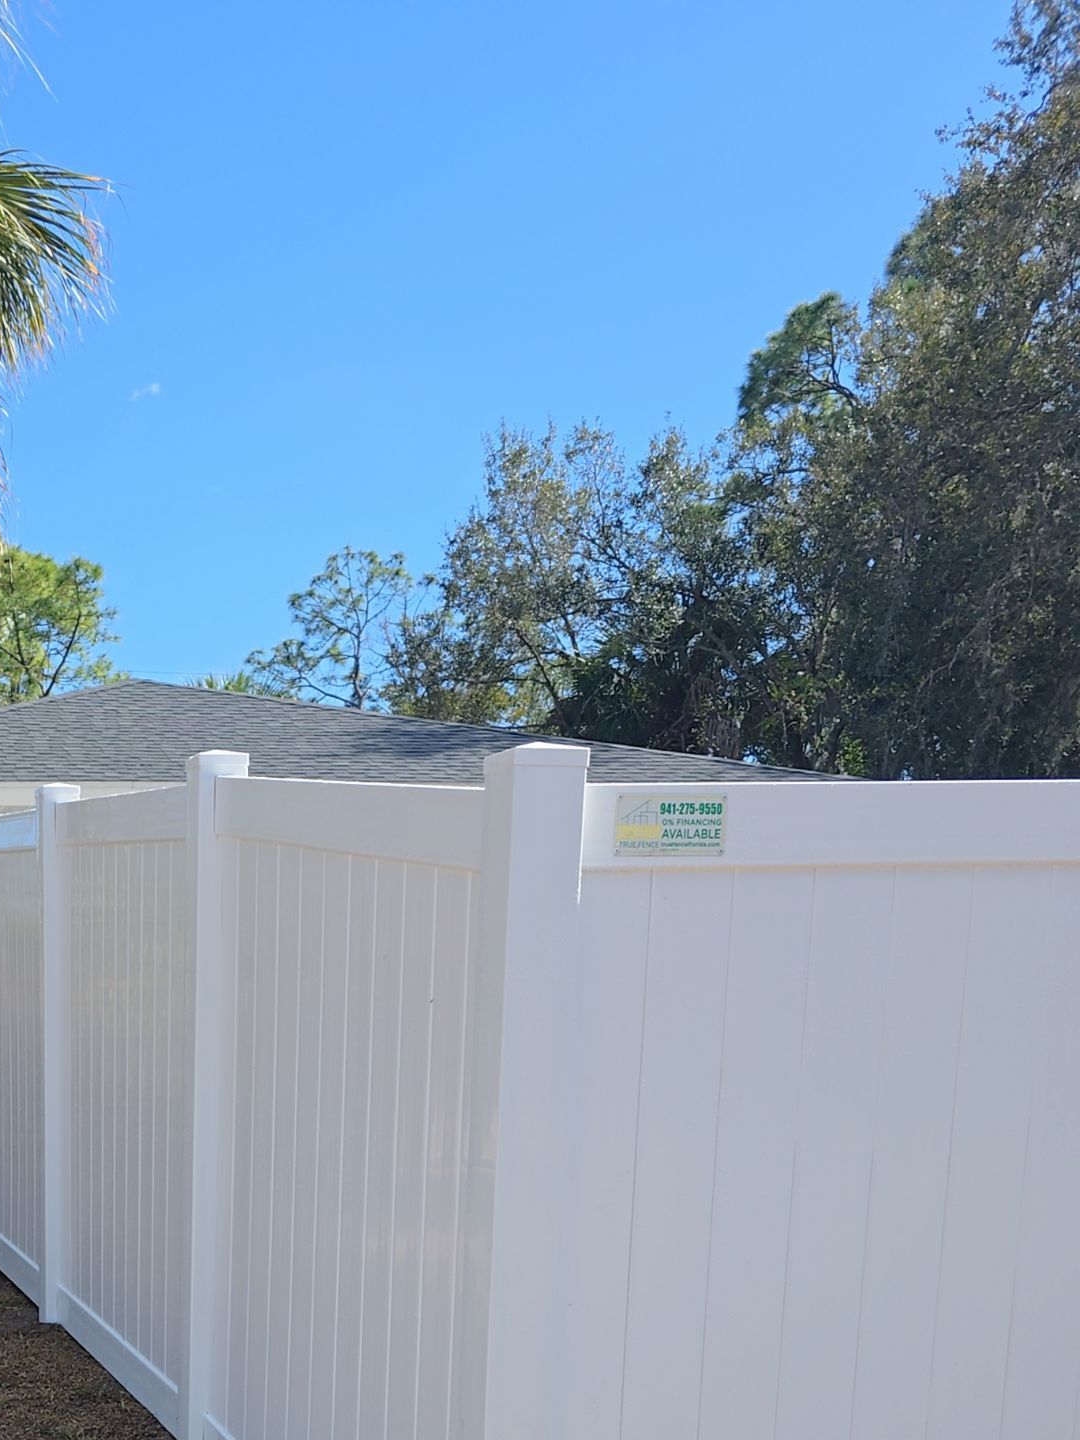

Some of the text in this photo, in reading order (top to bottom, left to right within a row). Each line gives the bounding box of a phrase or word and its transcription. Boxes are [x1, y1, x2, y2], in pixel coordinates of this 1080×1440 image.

[660, 802, 723, 815] 941-275-9550
[662, 818, 722, 826] 0% FINANCING
[661, 829, 721, 839] AVAILABLE
